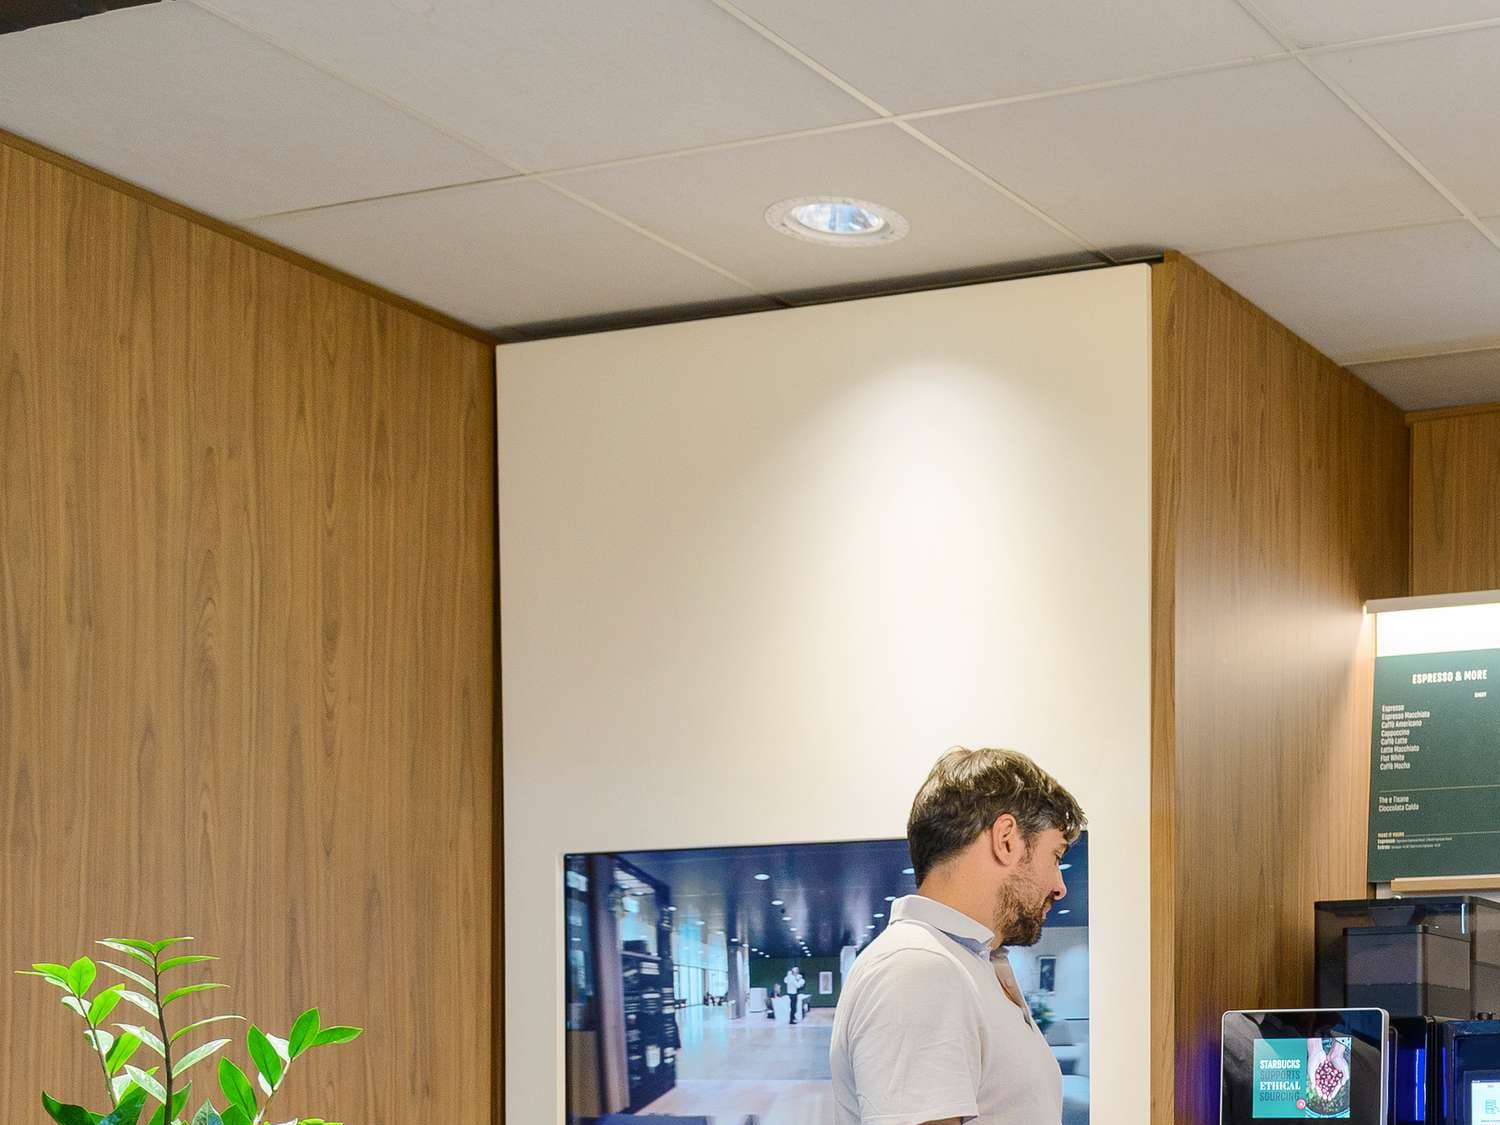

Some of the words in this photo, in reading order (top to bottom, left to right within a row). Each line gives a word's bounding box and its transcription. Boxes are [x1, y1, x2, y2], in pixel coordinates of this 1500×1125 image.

[1412, 671, 1453, 684] ESPRESSO
[1455, 671, 1463, 682] &
[1464, 669, 1488, 681] MORE
[1382, 705, 1405, 713] Espresso
[1381, 712, 1405, 721] Espresso
[1260, 1059, 1300, 1069] STARBUCKS
[1260, 1070, 1300, 1080] SUPPORTS
[1260, 1081, 1301, 1091] ETHICAL
[1260, 1091, 1300, 1102] SOURCING
